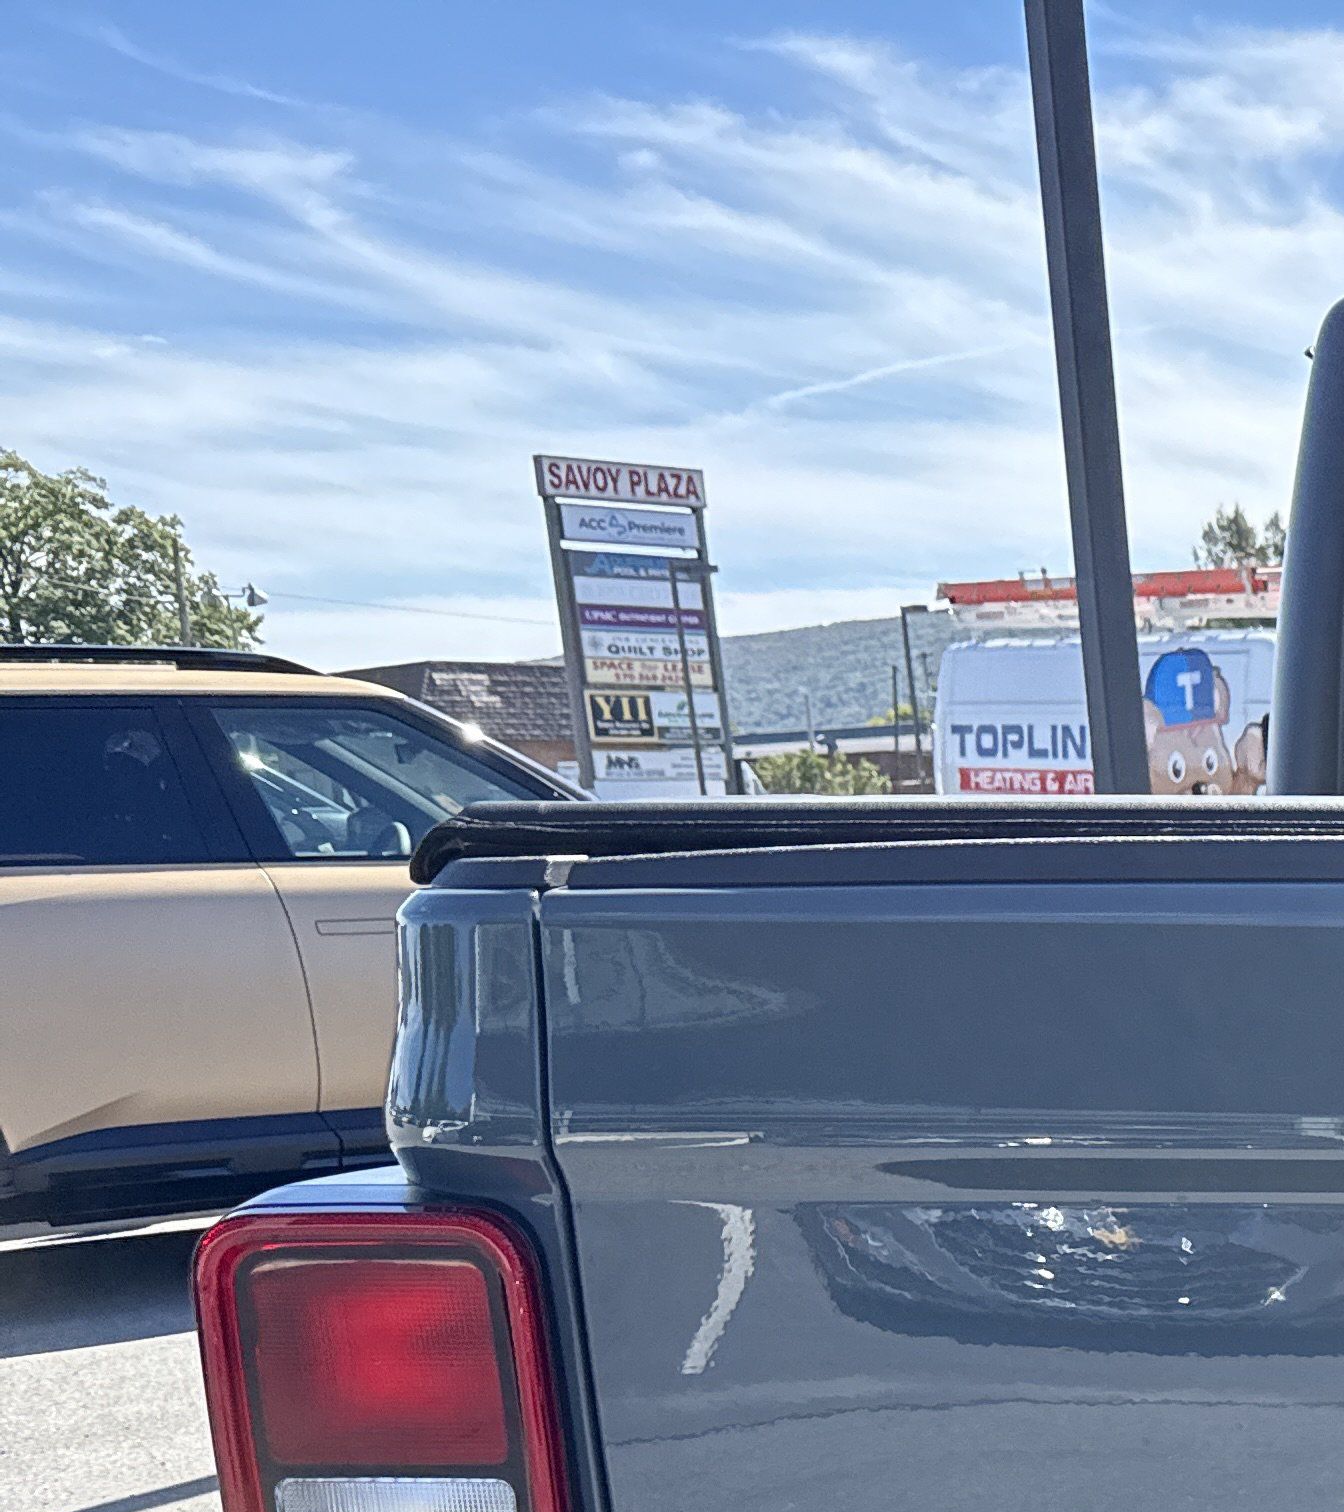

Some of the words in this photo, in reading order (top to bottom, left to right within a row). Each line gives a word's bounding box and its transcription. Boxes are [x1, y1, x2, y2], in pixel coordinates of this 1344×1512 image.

[548, 462, 621, 495] SAVOY
[629, 469, 700, 501] PLAZA
[579, 517, 607, 532] ACC
[628, 521, 686, 537] Premiere
[607, 643, 657, 656] QUILT
[592, 660, 635, 672] SPACE
[1176, 671, 1201, 712] T
[970, 769, 1041, 791] HEATING
[1046, 772, 1060, 791] &
[1064, 773, 1095, 794] AIR
